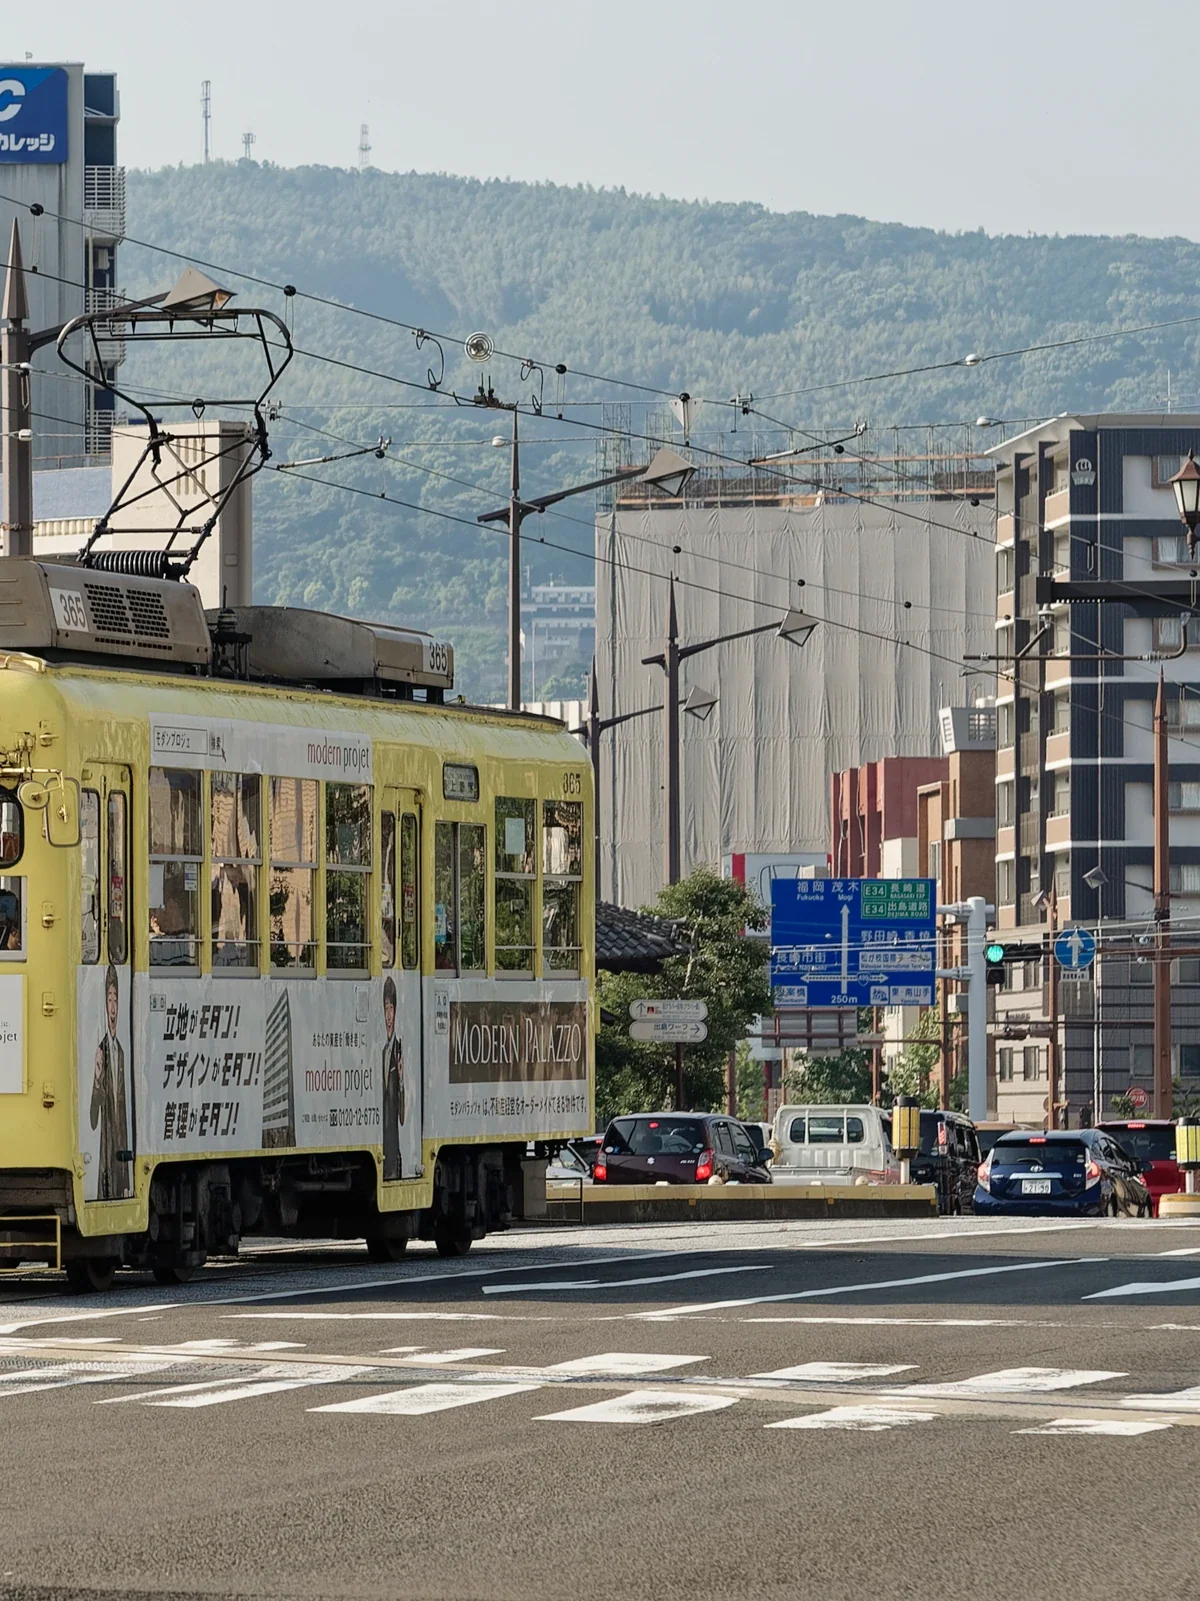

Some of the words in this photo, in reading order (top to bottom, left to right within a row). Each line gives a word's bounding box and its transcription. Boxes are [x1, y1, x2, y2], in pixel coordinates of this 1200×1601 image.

[60, 593, 86, 628] 365
[429, 641, 448, 672] 365
[307, 736, 342, 767] modern
[343, 739, 370, 773] projet
[563, 773, 581, 795] 365
[797, 881, 825, 893] 福岡
[832, 881, 859, 893] 茂木
[797, 893, 825, 901] Fukuoka
[838, 893, 854, 901] Mogi
[865, 885, 884, 896] E34
[890, 882, 926, 893] 長崎道
[865, 903, 884, 915] E34
[888, 901, 928, 912] 出島道路
[831, 995, 858, 1004] 250m
[163, 1003, 241, 1041] 立地がモダン！
[454, 1017, 520, 1065] MODERN
[525, 1017, 582, 1063] PALAZZO
[163, 1052, 262, 1090] デザインがモダン！
[305, 1059, 342, 1092] modern
[344, 1059, 373, 1098] projet
[163, 1101, 241, 1140] 管理がモダン！
